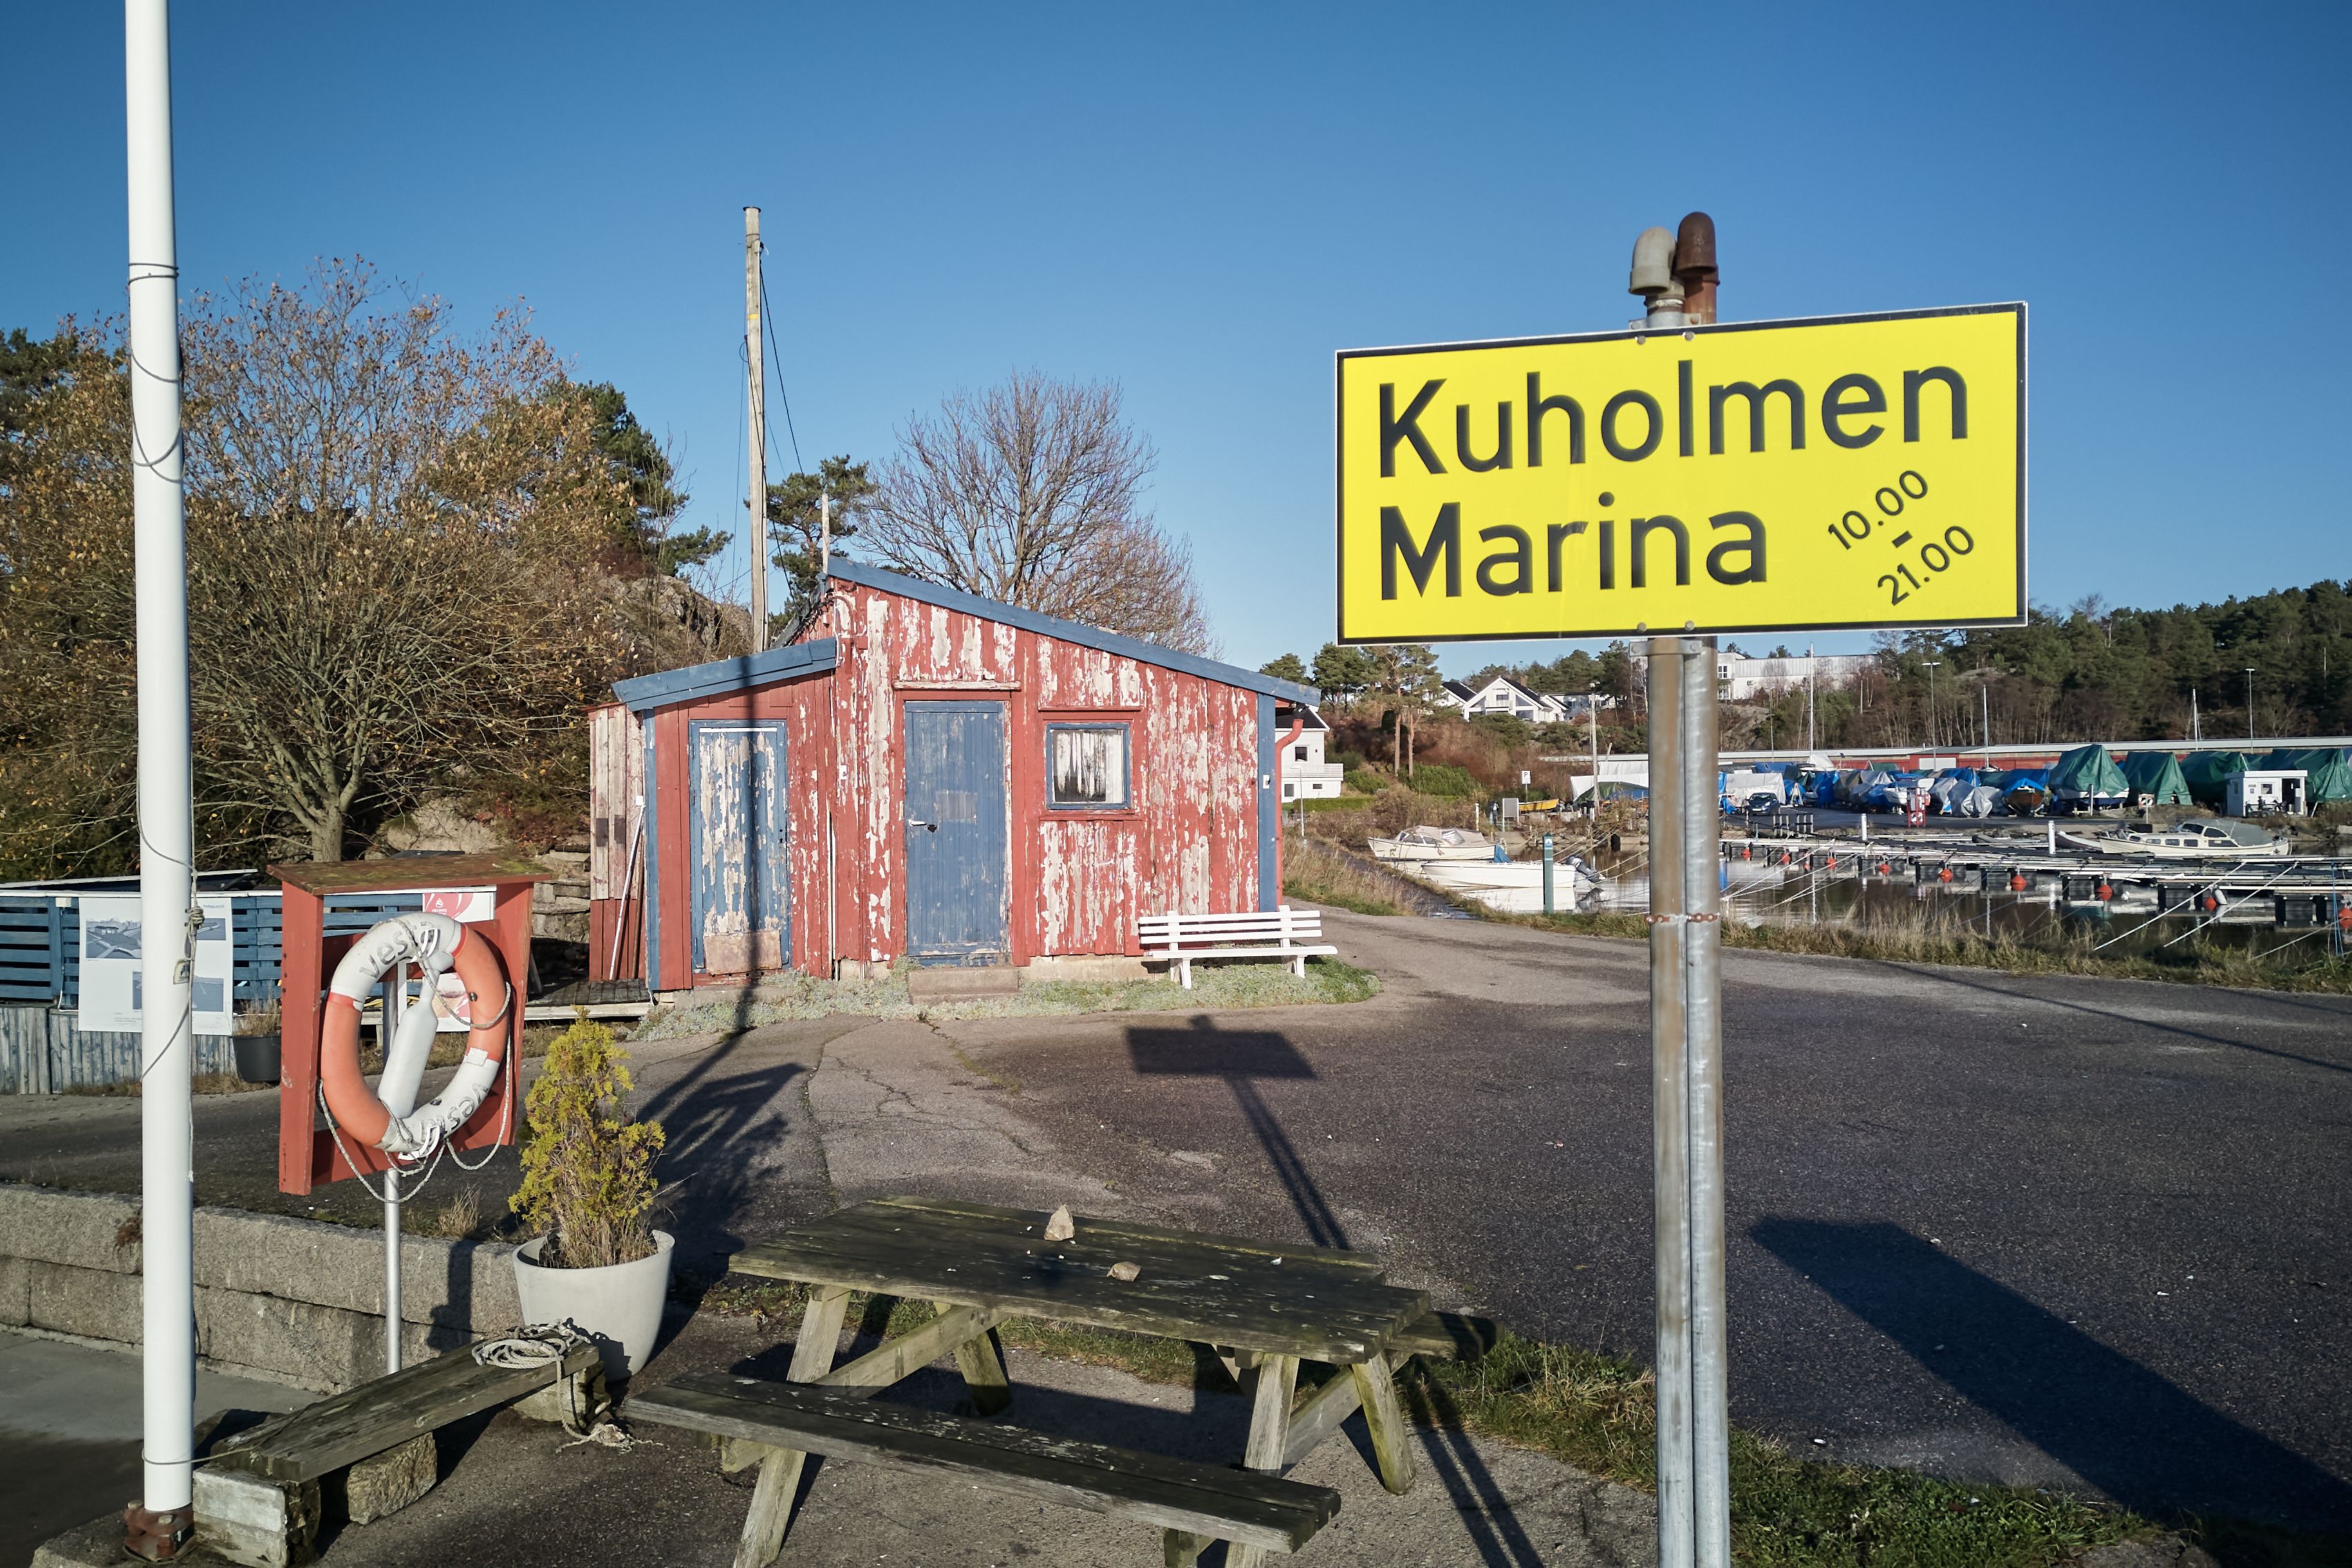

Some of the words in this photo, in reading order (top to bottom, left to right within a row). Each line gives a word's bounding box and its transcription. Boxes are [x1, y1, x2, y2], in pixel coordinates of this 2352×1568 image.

[1379, 360, 1968, 478] Kuholmen
[1380, 492, 1767, 601] Marina
[1828, 470, 1928, 550] 10.00
[1877, 525, 1975, 606] 21.00
